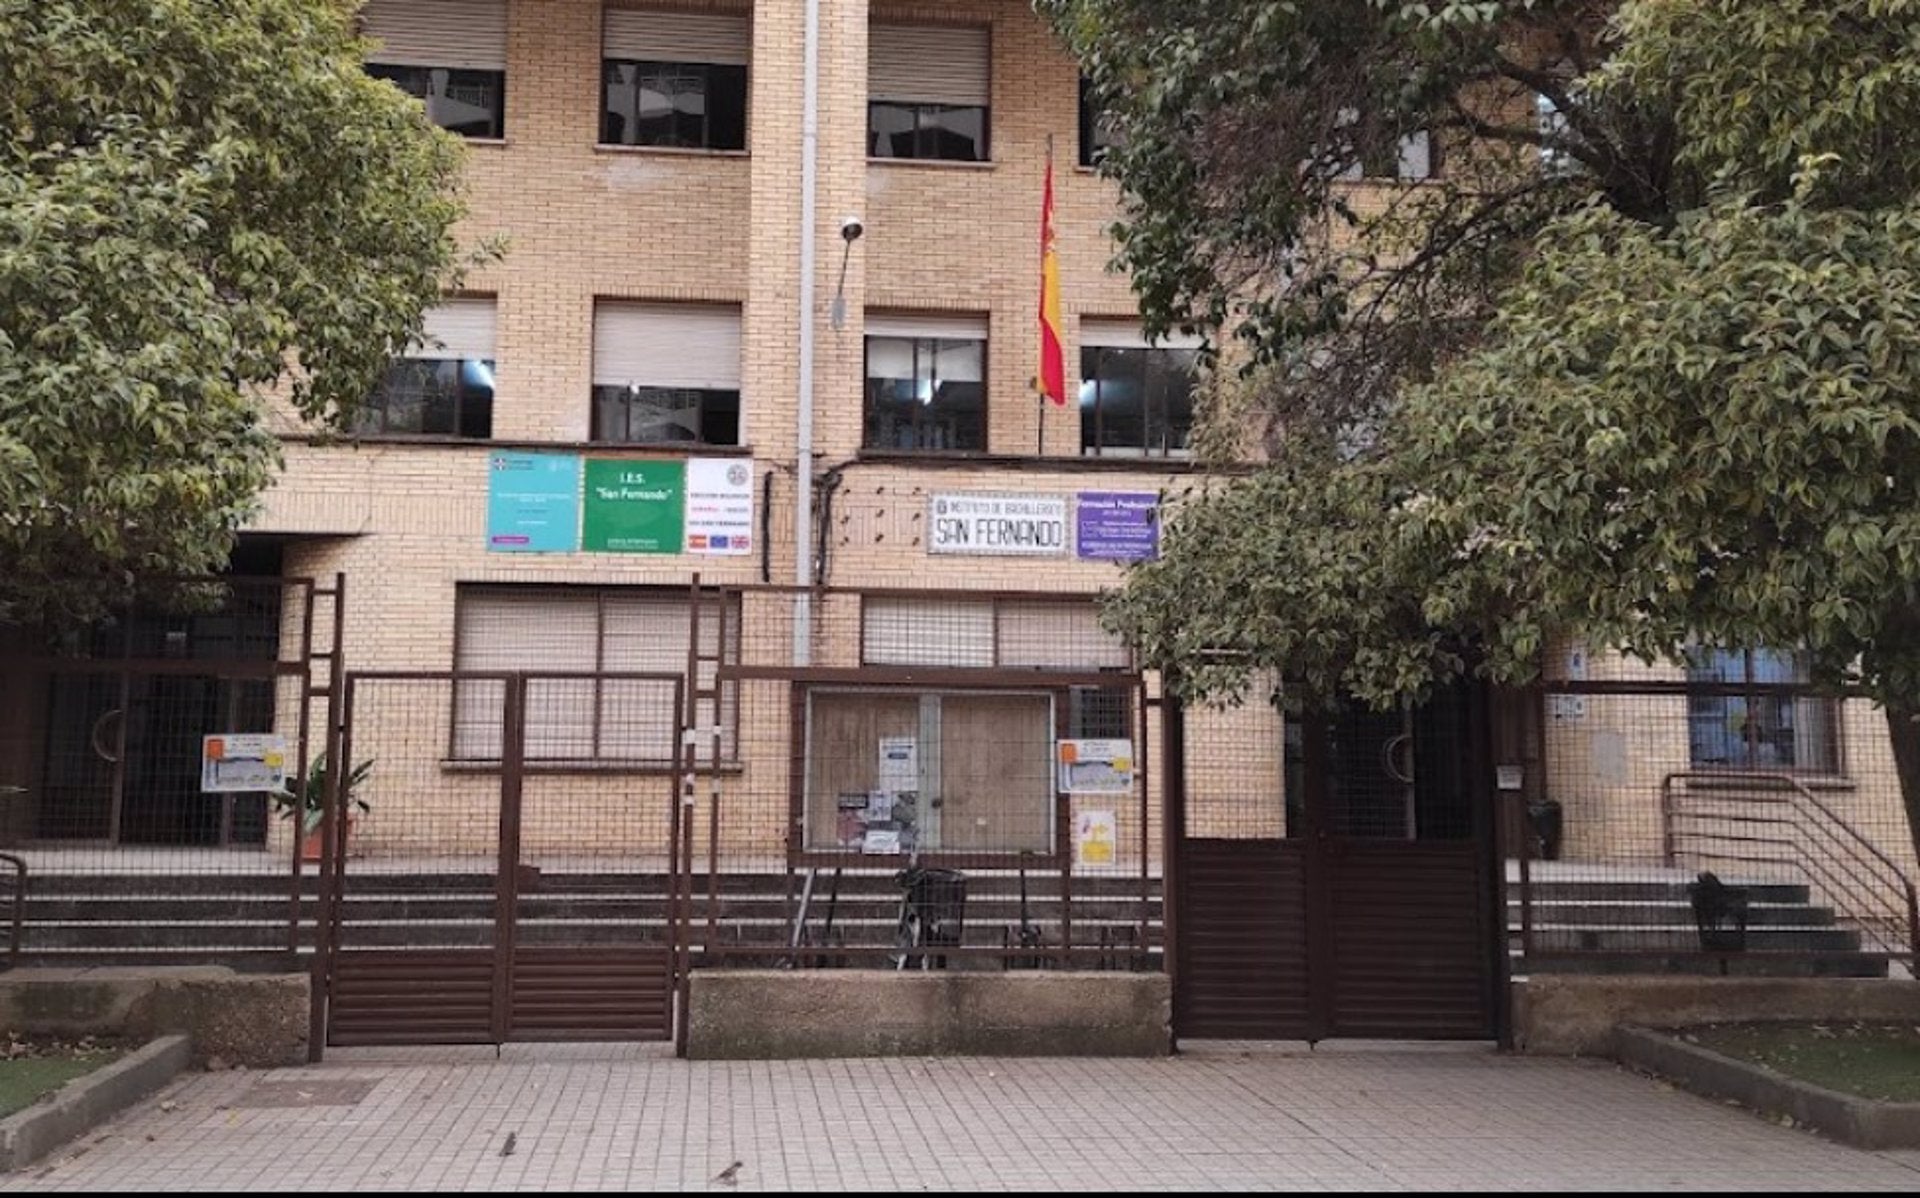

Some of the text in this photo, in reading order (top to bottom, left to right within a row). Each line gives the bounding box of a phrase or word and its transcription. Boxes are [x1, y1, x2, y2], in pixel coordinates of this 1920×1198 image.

[619, 472, 646, 484] I.E.S.
[937, 518, 969, 544] SAN
[976, 518, 1062, 547] FERNANDO
